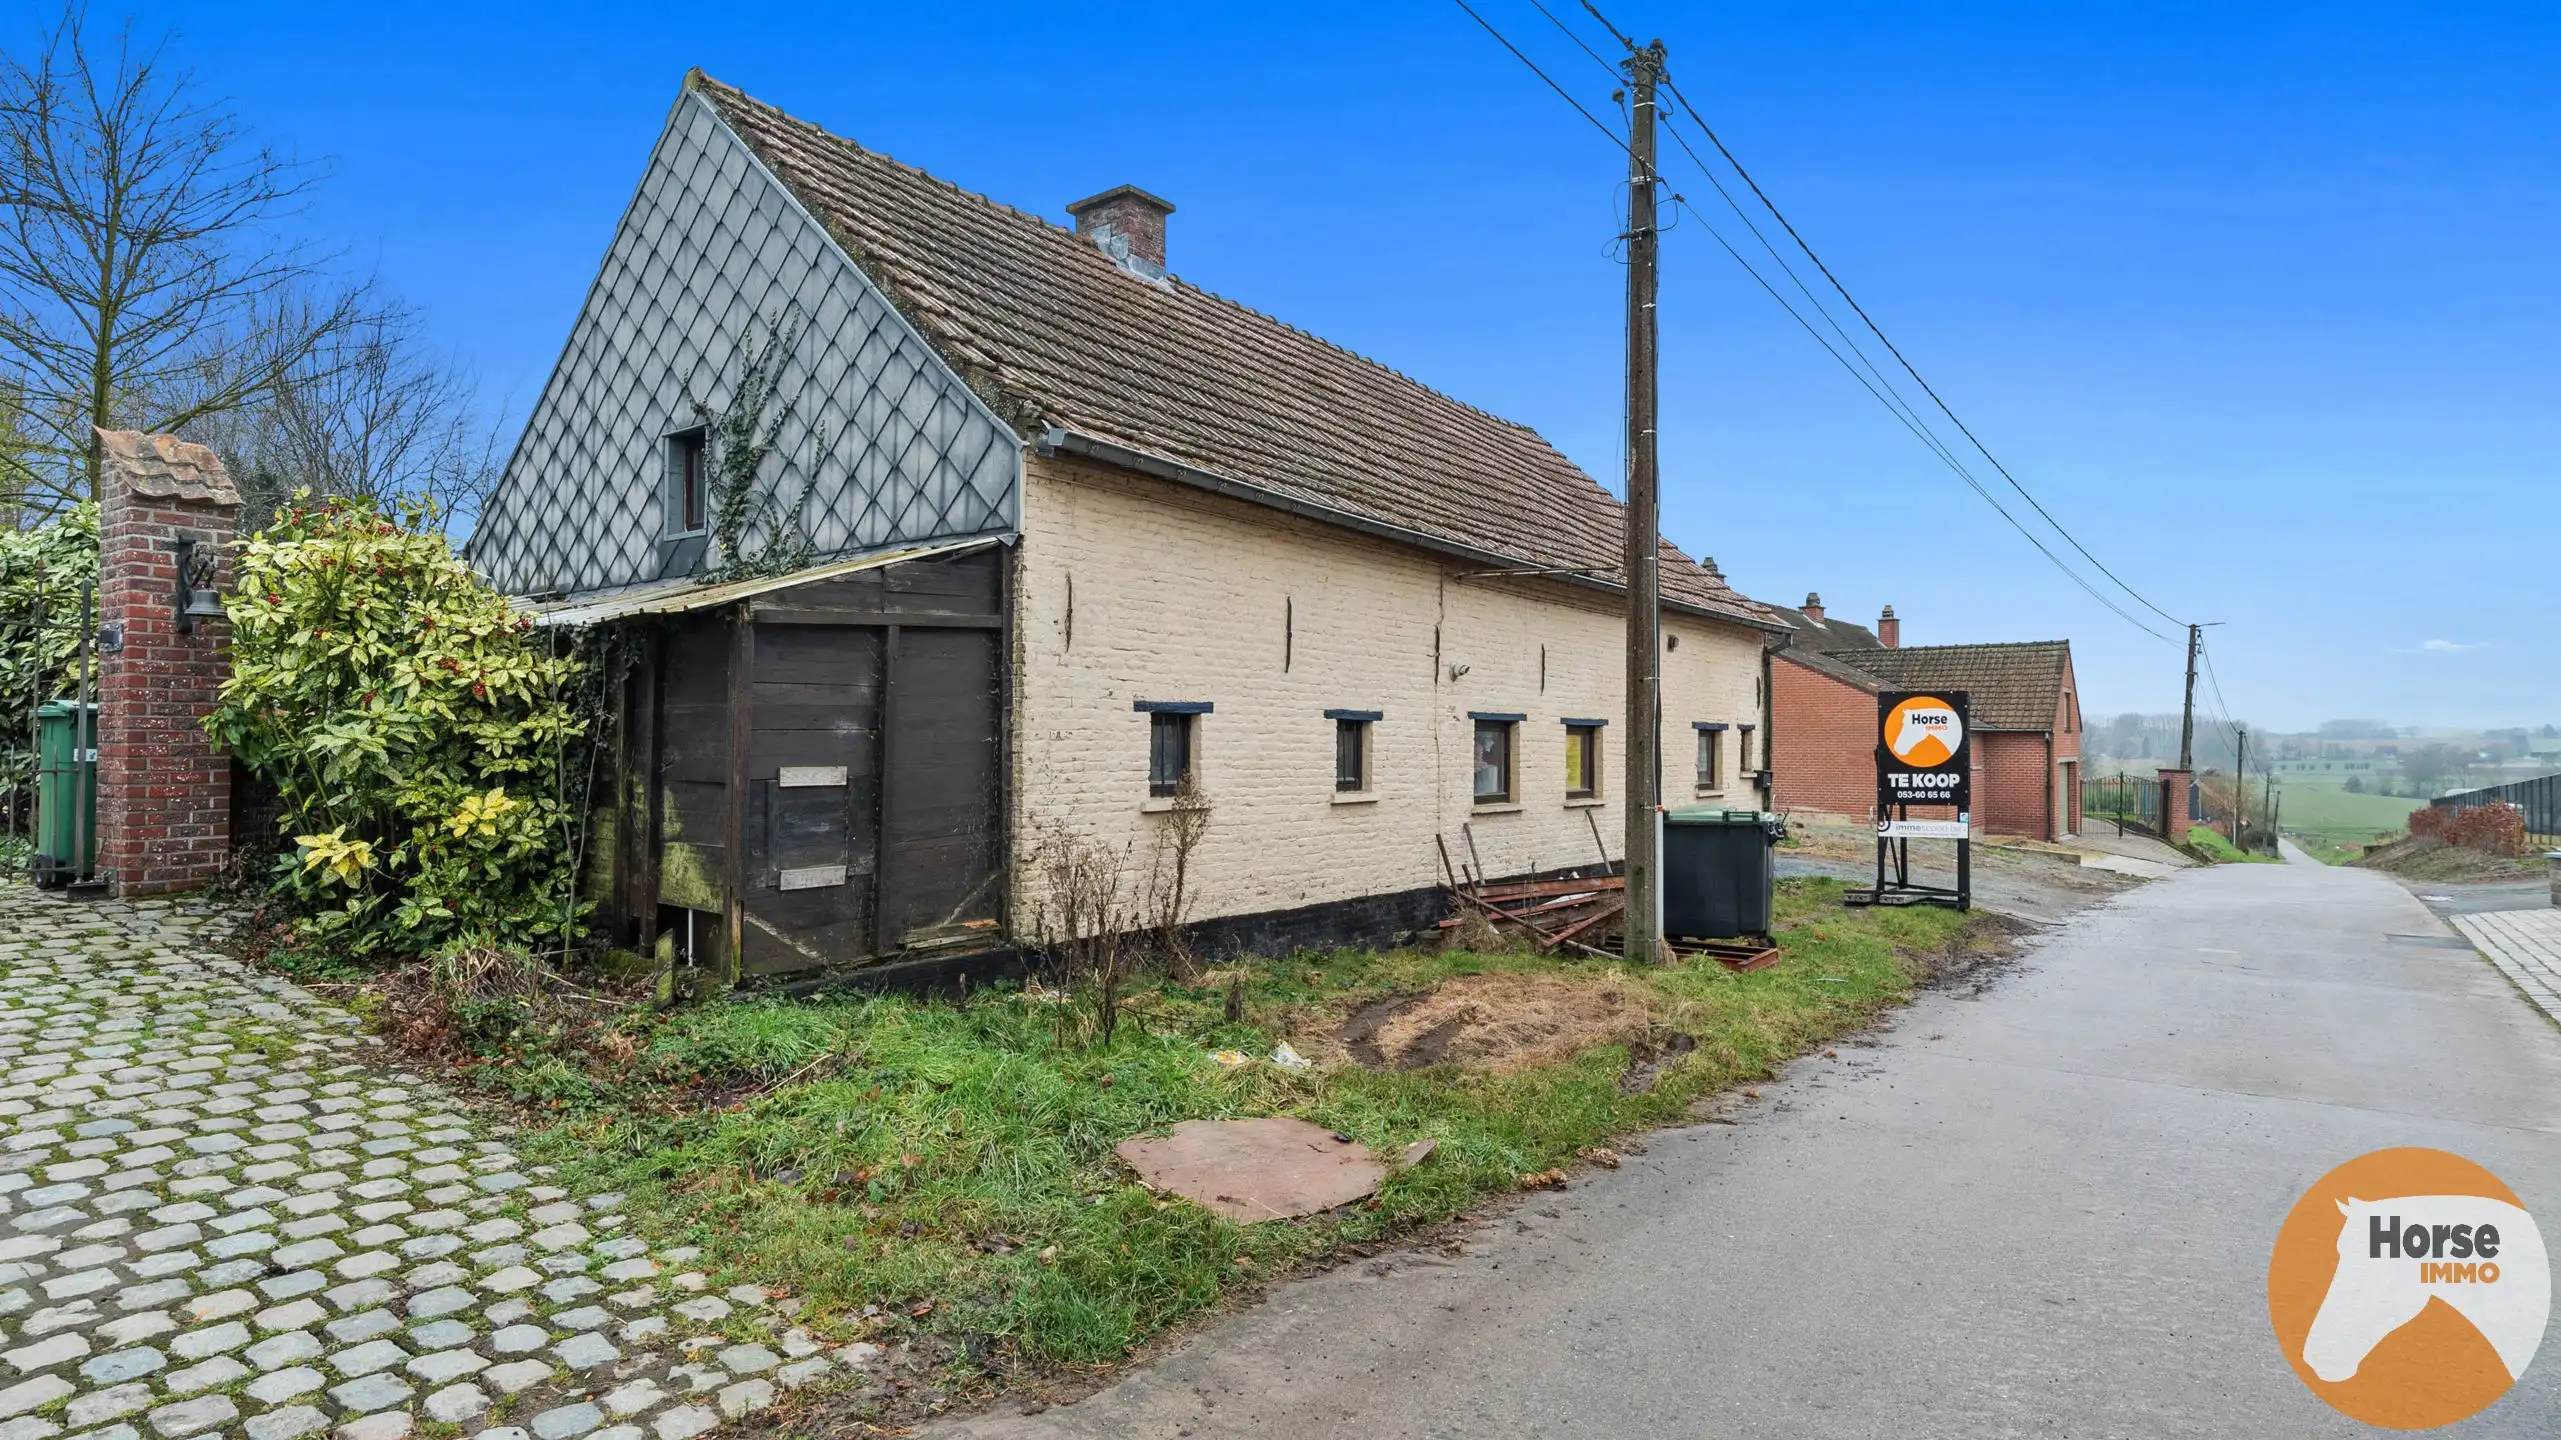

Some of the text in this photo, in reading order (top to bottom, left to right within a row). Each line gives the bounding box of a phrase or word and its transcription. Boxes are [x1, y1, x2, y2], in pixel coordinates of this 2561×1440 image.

[1912, 714, 1947, 724] Horse
[1887, 773, 1960, 788] TE KOOP
